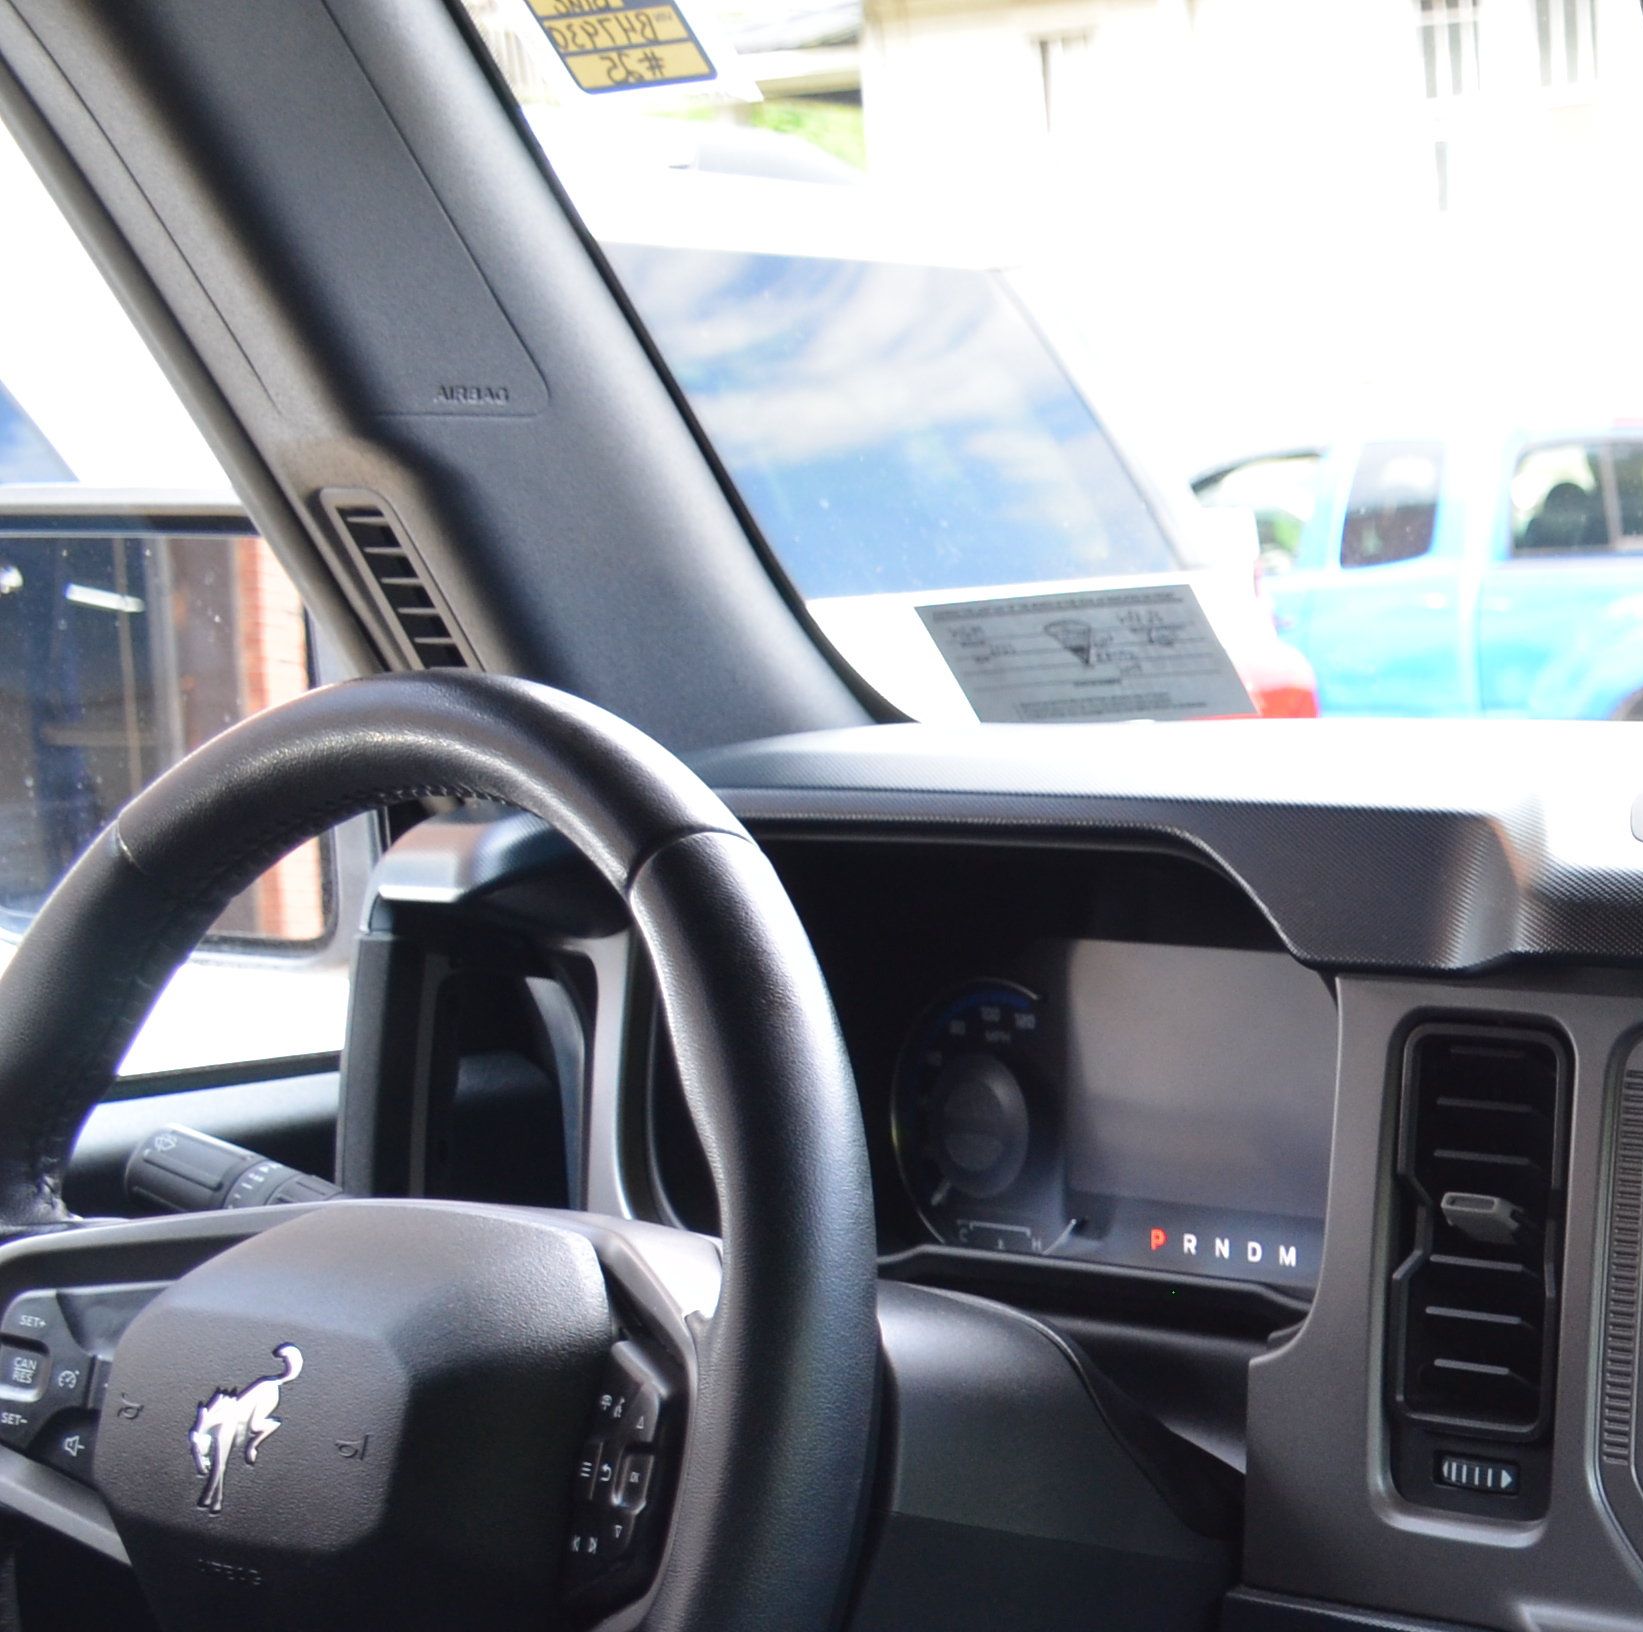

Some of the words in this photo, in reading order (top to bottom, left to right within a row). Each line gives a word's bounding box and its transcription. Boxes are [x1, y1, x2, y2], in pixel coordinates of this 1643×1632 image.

[433, 384, 509, 406] AIRBAG
[1150, 1227, 1167, 1251] P
[1183, 1233, 1198, 1255] R
[1215, 1237, 1230, 1259] N
[1247, 1241, 1262, 1262] D
[1279, 1245, 1296, 1267] M
[19, 1314, 47, 1328] SET+
[13, 1356, 38, 1370] CAN
[12, 1370, 34, 1385] RES
